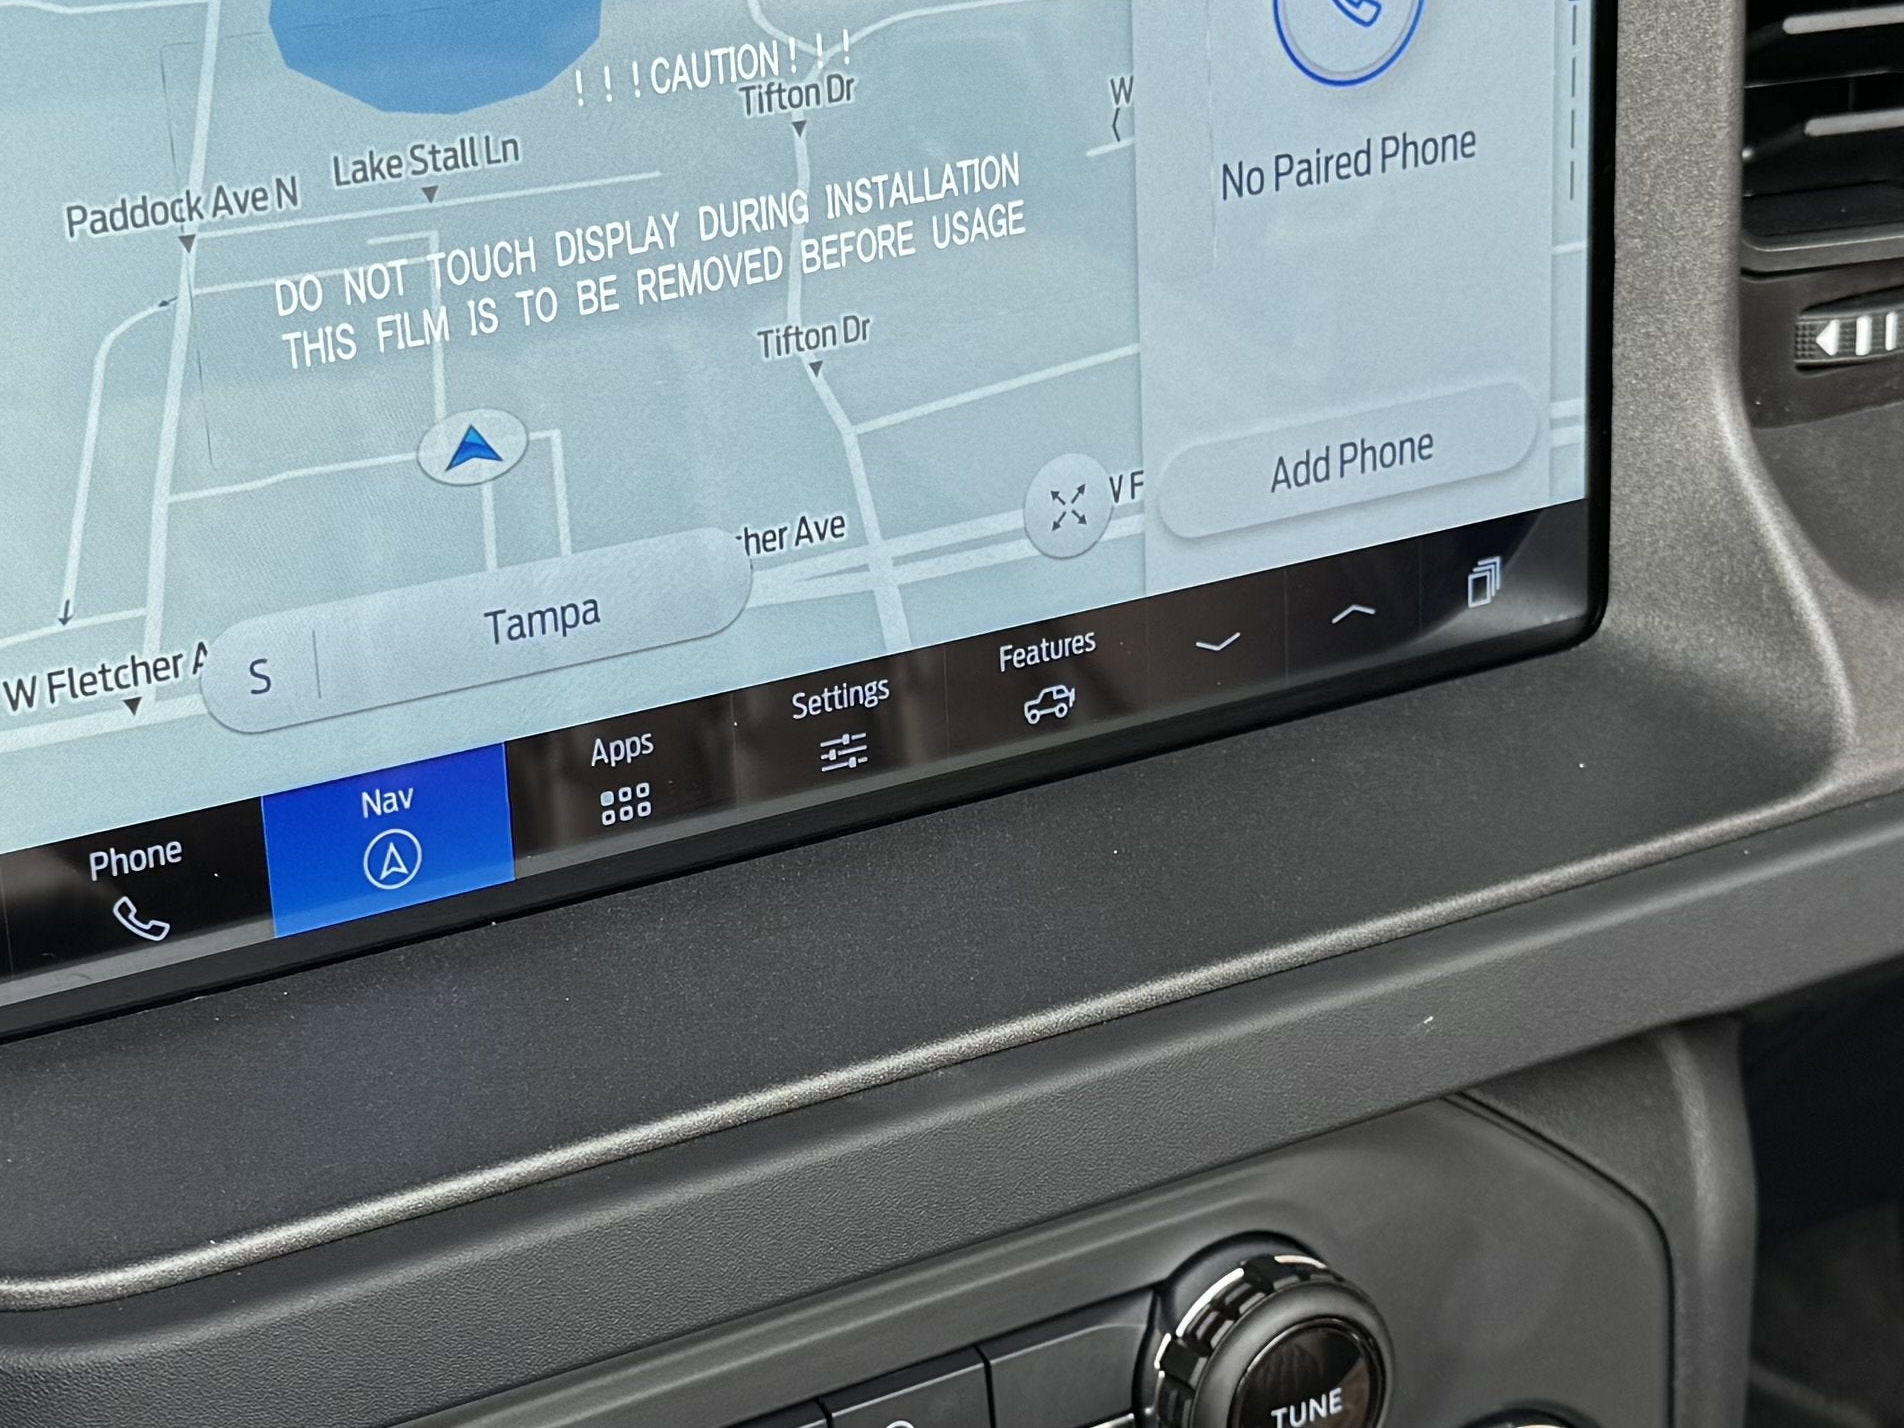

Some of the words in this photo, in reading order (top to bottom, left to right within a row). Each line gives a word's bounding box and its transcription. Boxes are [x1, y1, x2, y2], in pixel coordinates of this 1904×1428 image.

[740, 79, 821, 117] Tifton
[826, 73, 855, 106] Dr
[333, 151, 403, 188] Lake
[410, 140, 478, 176] Stall
[484, 137, 520, 170] Ln
[1222, 163, 1265, 202] No
[1274, 139, 1371, 192] Paired
[1380, 129, 1477, 171] Phone
[67, 189, 204, 238] Paddock
[211, 182, 270, 217] Ave
[275, 177, 298, 209] N
[275, 277, 323, 317] DO
[343, 262, 406, 305] NOT
[428, 240, 537, 290] TOUCH
[555, 213, 680, 265] DISPLAY
[698, 191, 809, 243] DURING
[824, 152, 1020, 220] INSTALLATION
[282, 323, 357, 369] THIS
[376, 306, 450, 354] FILM
[469, 297, 499, 337] IS
[516, 288, 558, 325] TO
[576, 277, 620, 315] BE
[636, 247, 784, 305] REMOVED
[800, 224, 916, 276] BEFORE
[931, 201, 1027, 250] USAGE
[757, 320, 838, 358] Tifton
[841, 314, 871, 348] Dr
[1271, 446, 1331, 493] Add
[1339, 432, 1435, 478] Phone
[794, 515, 845, 547] Ave
[249, 658, 272, 695] S
[483, 595, 600, 646] Tampa
[999, 630, 1096, 673] Features
[3, 678, 39, 713] W
[48, 651, 183, 705] Fletcher
[792, 677, 890, 721] Settings
[591, 728, 654, 767] Apps
[361, 787, 414, 819] Nav
[89, 838, 183, 882] Phone
